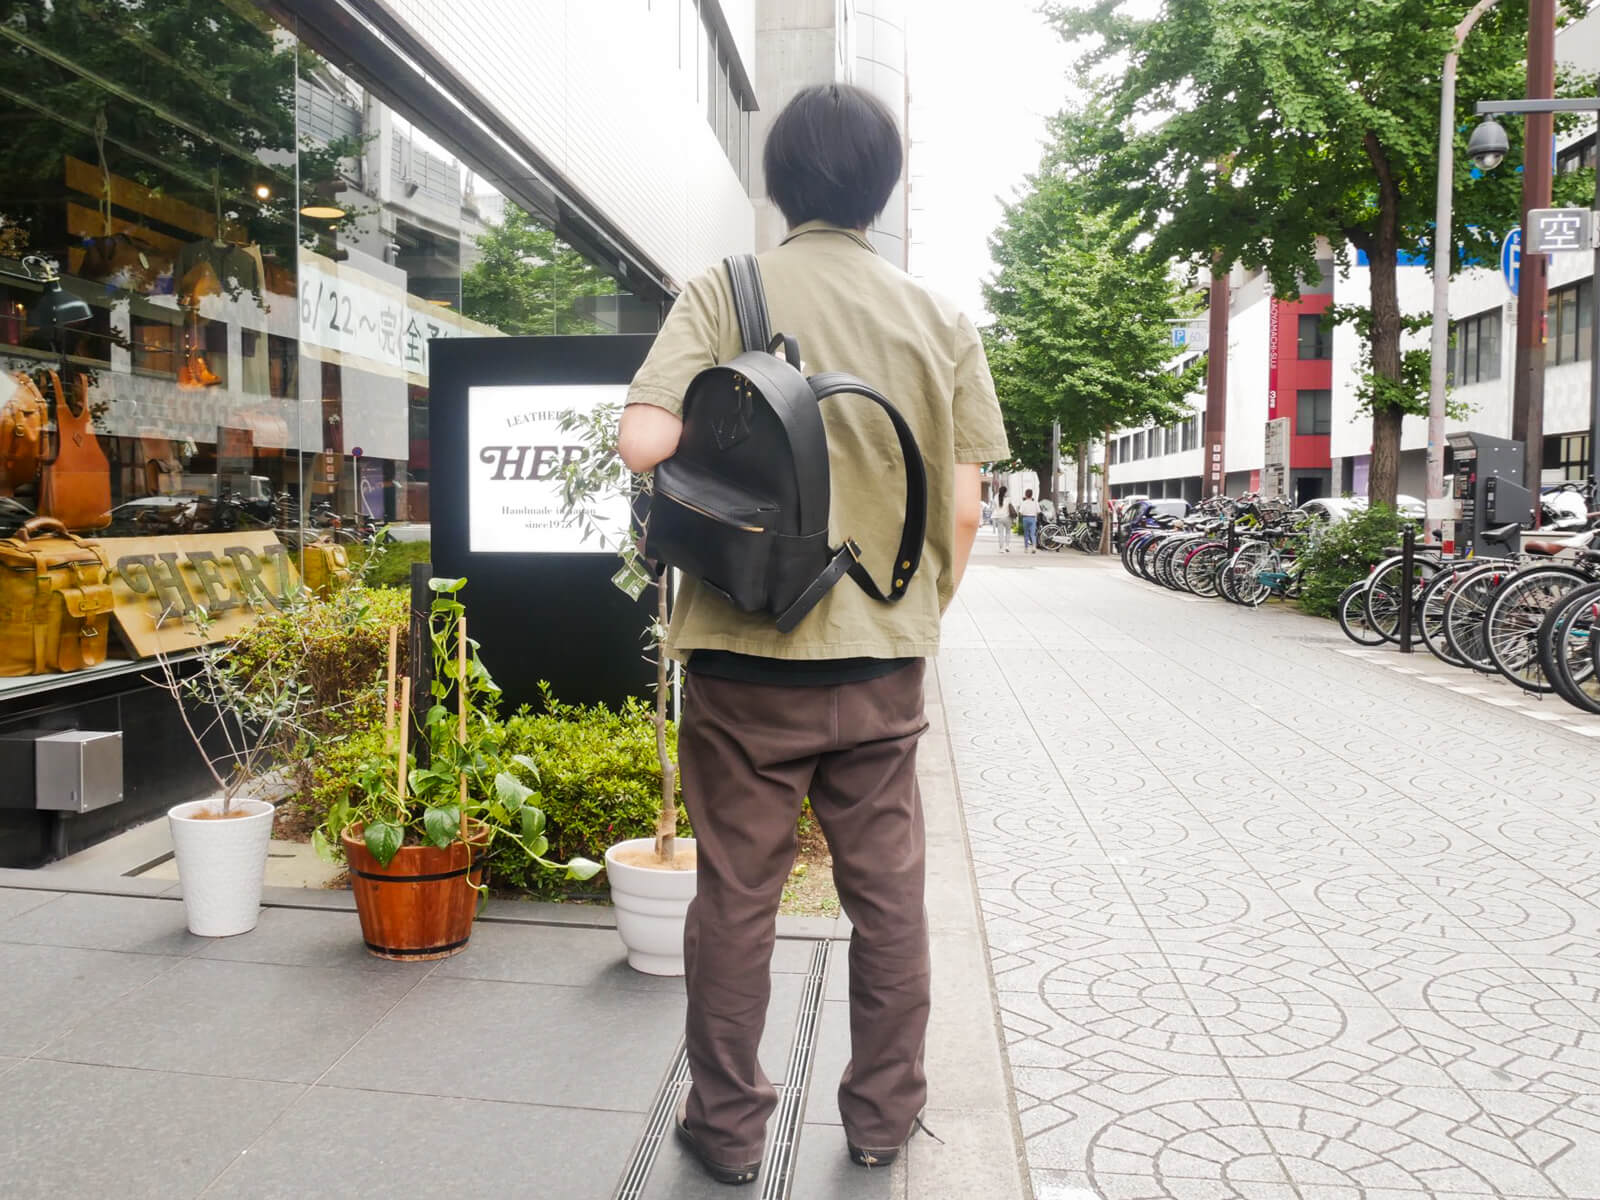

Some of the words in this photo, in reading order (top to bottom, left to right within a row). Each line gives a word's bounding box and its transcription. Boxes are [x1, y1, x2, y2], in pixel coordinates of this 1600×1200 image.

[1539, 213, 1580, 249] 空
[301, 279, 449, 364] 6/22～完全
[502, 505, 552, 515] Handmade
